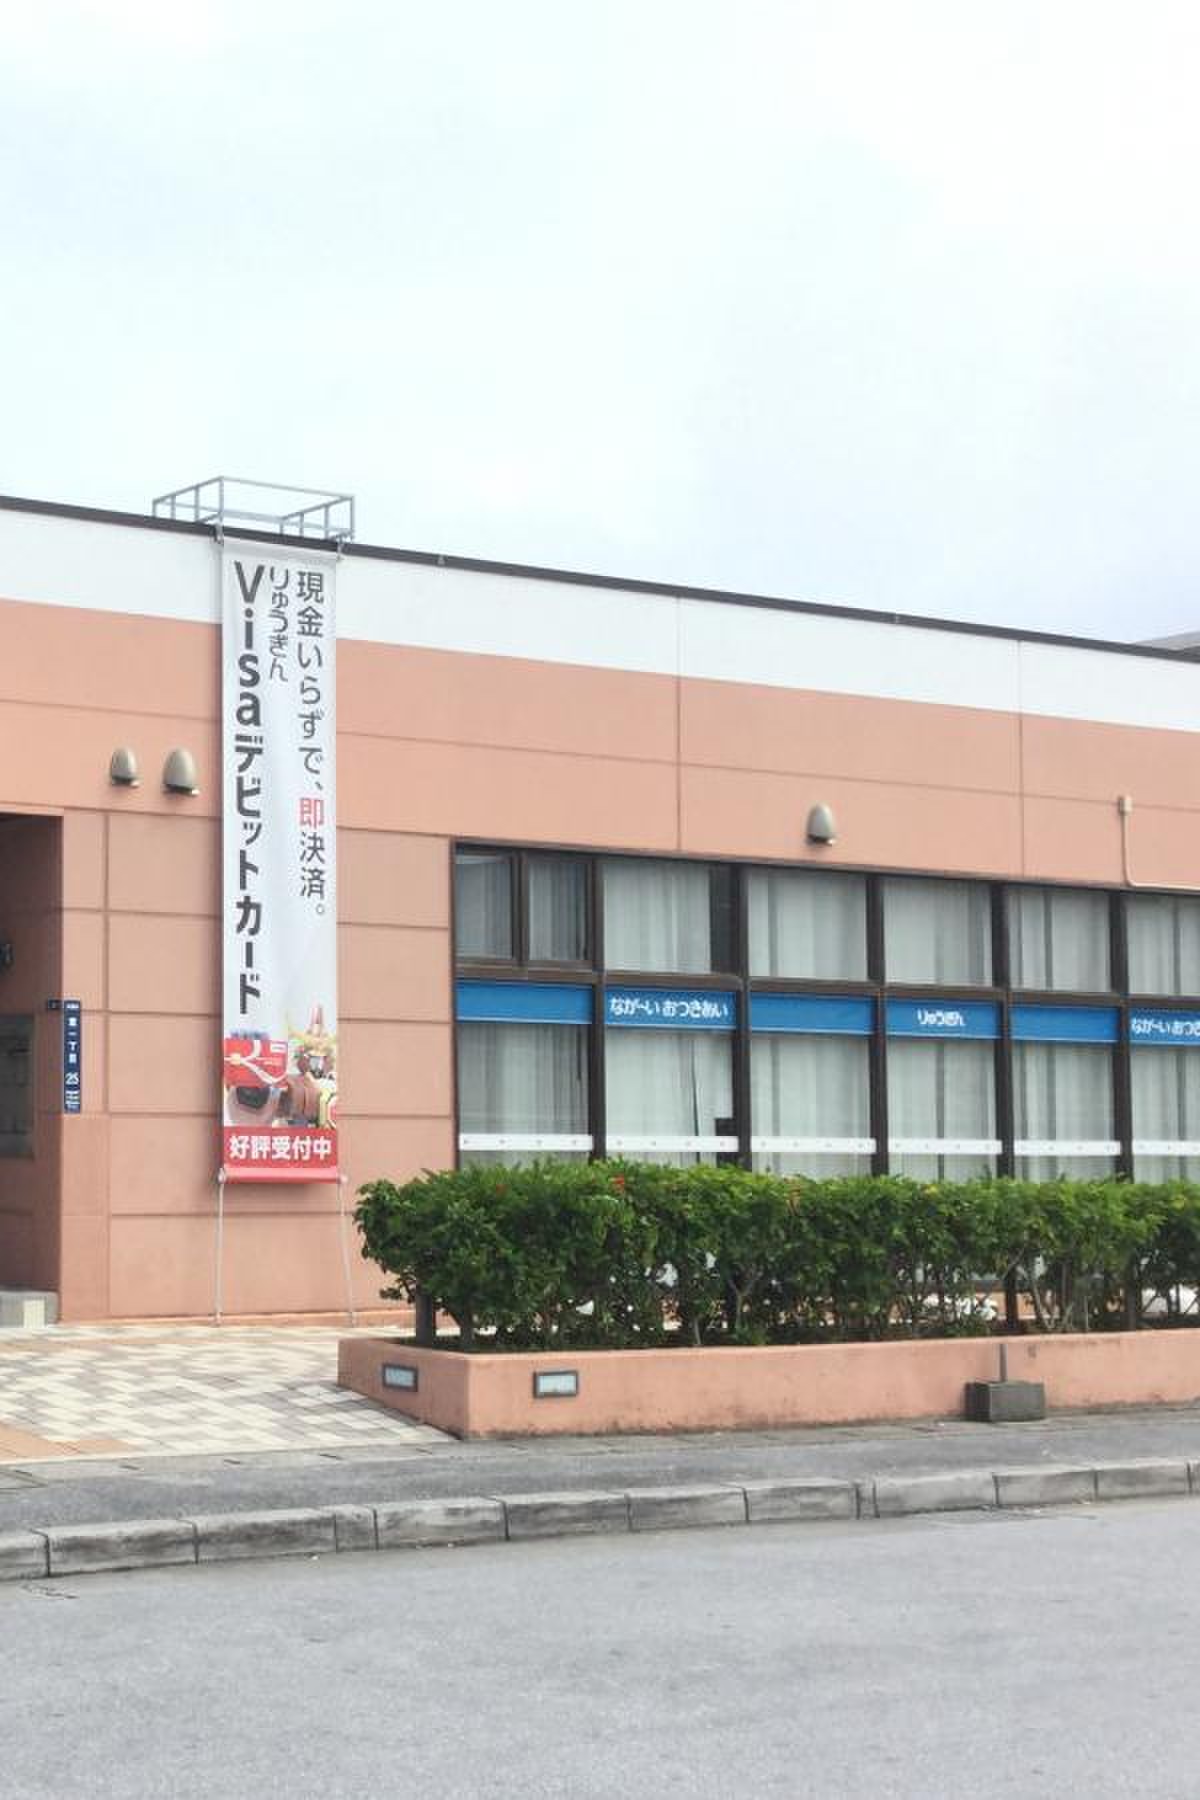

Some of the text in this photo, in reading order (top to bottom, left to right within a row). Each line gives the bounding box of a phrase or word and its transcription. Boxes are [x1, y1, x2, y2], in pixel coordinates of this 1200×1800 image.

[268, 565, 289, 683] りゅうぎん
[233, 560, 266, 1015] Visaデビットカード
[296, 570, 326, 915] 現金いらずで、即決済。
[229, 1135, 332, 1160] 好評受付中
